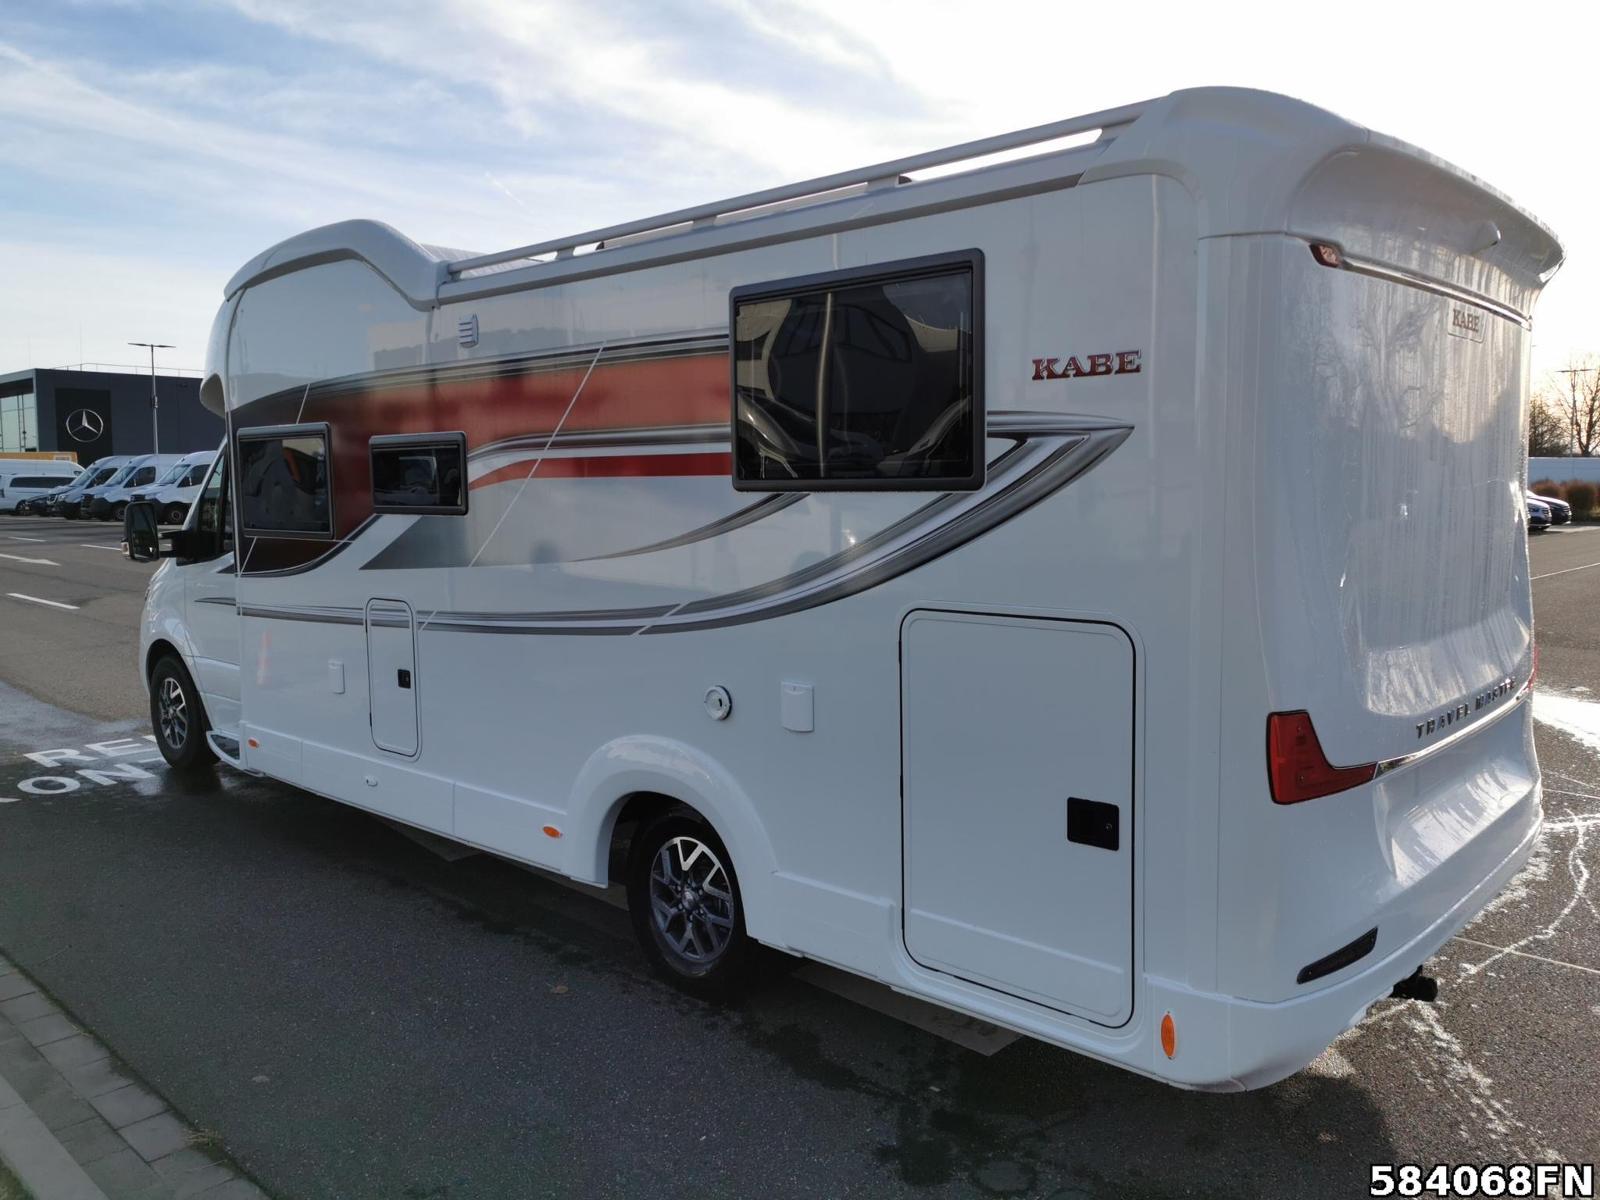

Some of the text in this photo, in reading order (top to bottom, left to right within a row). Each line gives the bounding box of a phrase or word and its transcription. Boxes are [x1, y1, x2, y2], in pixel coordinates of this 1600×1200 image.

[1453, 308, 1480, 333] KABE
[1032, 350, 1142, 381] KABE
[1415, 702, 1470, 739] TRAVEL
